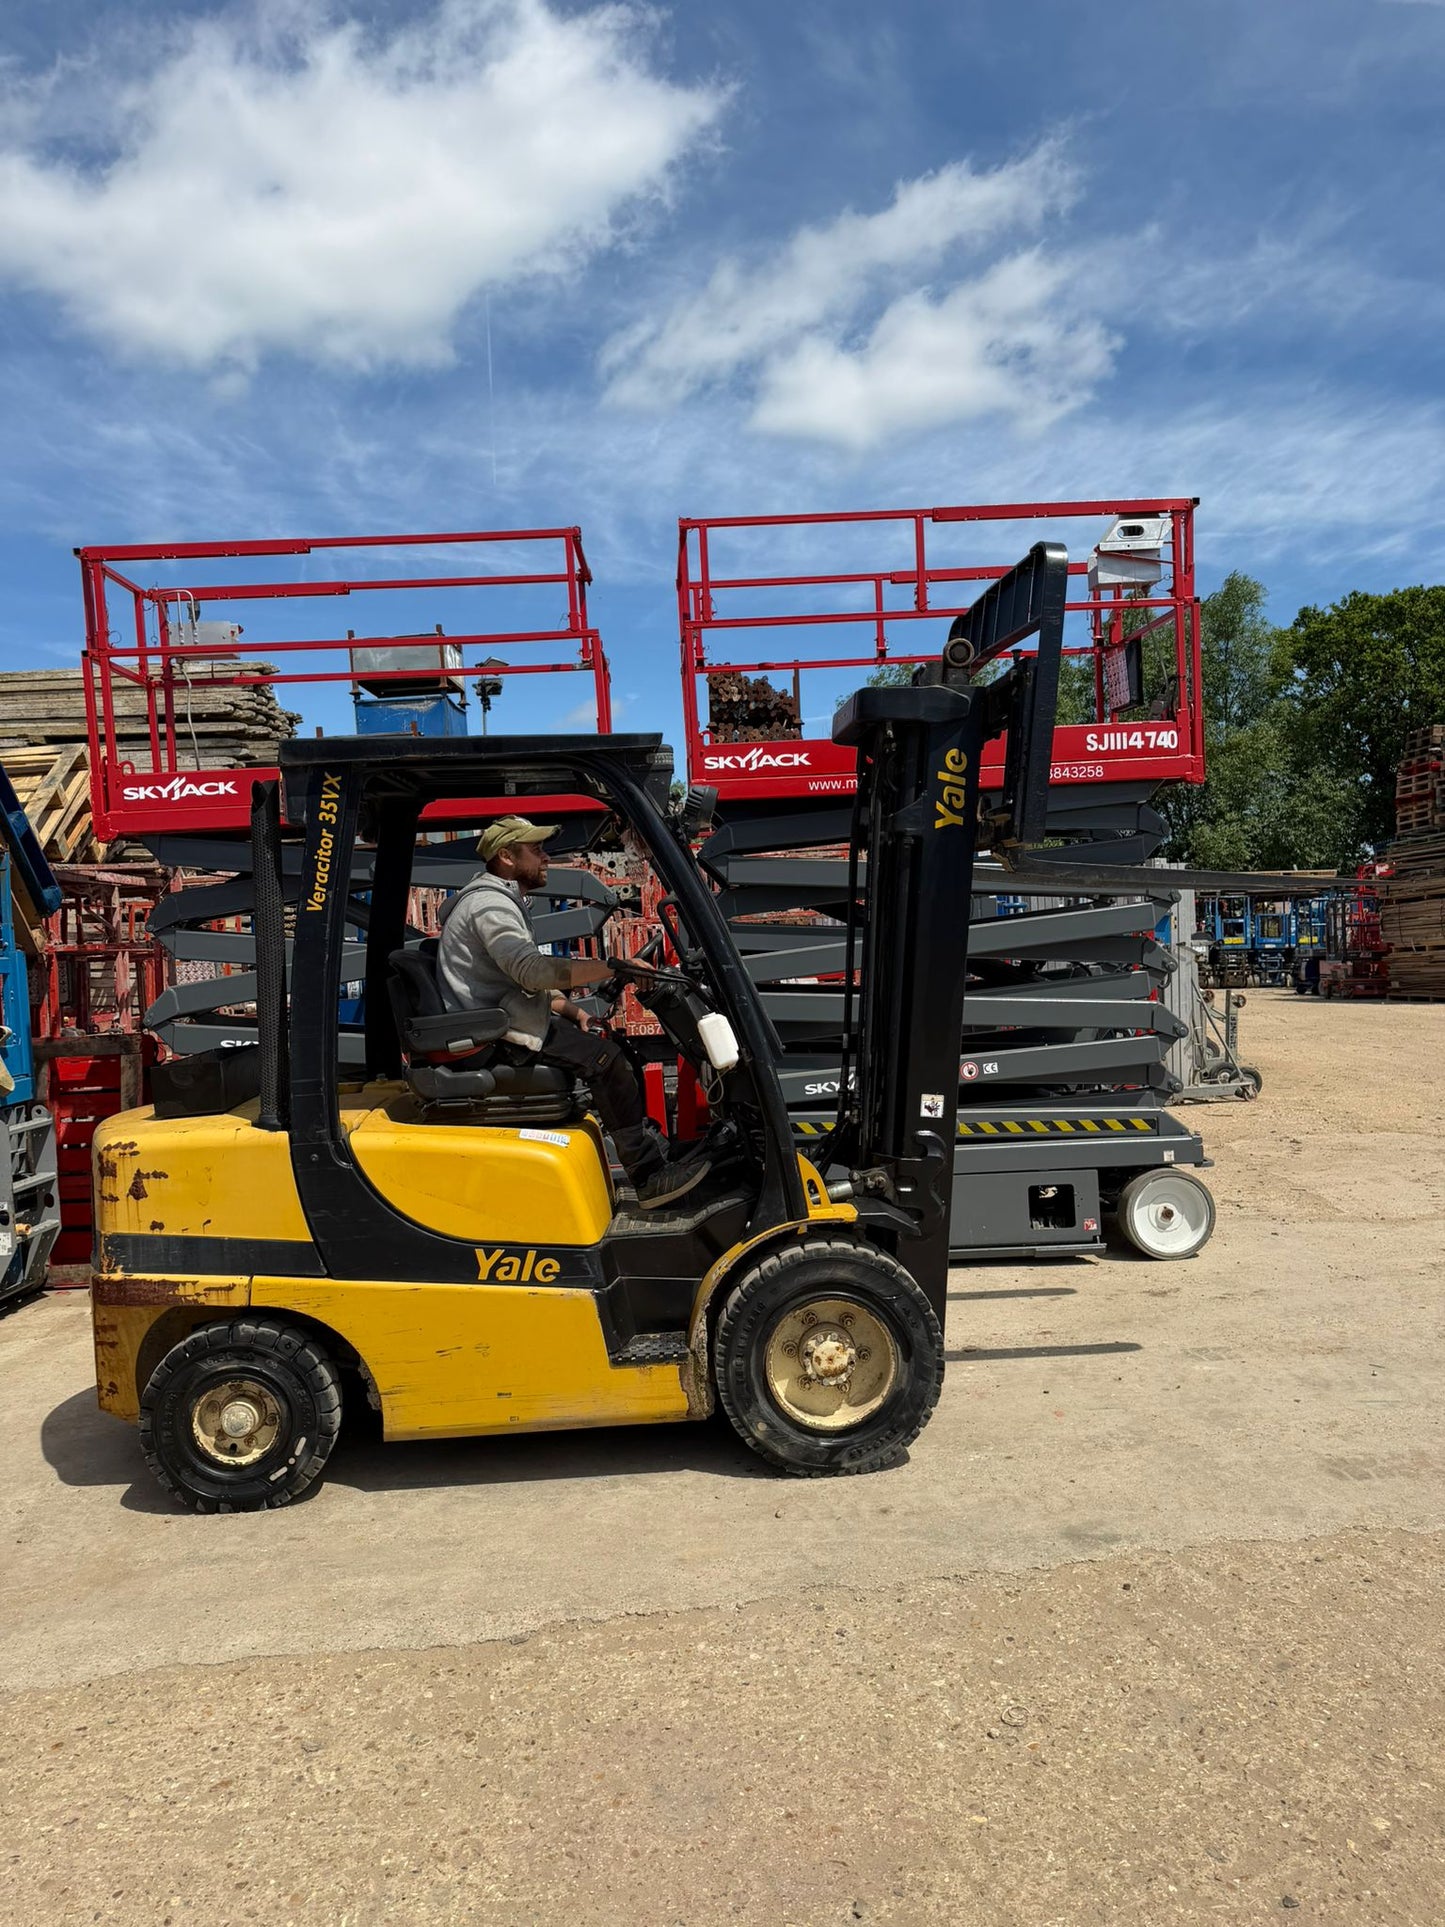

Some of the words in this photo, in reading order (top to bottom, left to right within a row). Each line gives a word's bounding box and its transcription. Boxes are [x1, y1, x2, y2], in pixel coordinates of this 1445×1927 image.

[704, 747, 812, 771] SKYJACK
[123, 776, 239, 801] SKYJACK
[318, 771, 342, 824] 35VX
[935, 748, 968, 829] Yale
[306, 828, 334, 911] Veracitor
[475, 1248, 561, 1282] Yale
